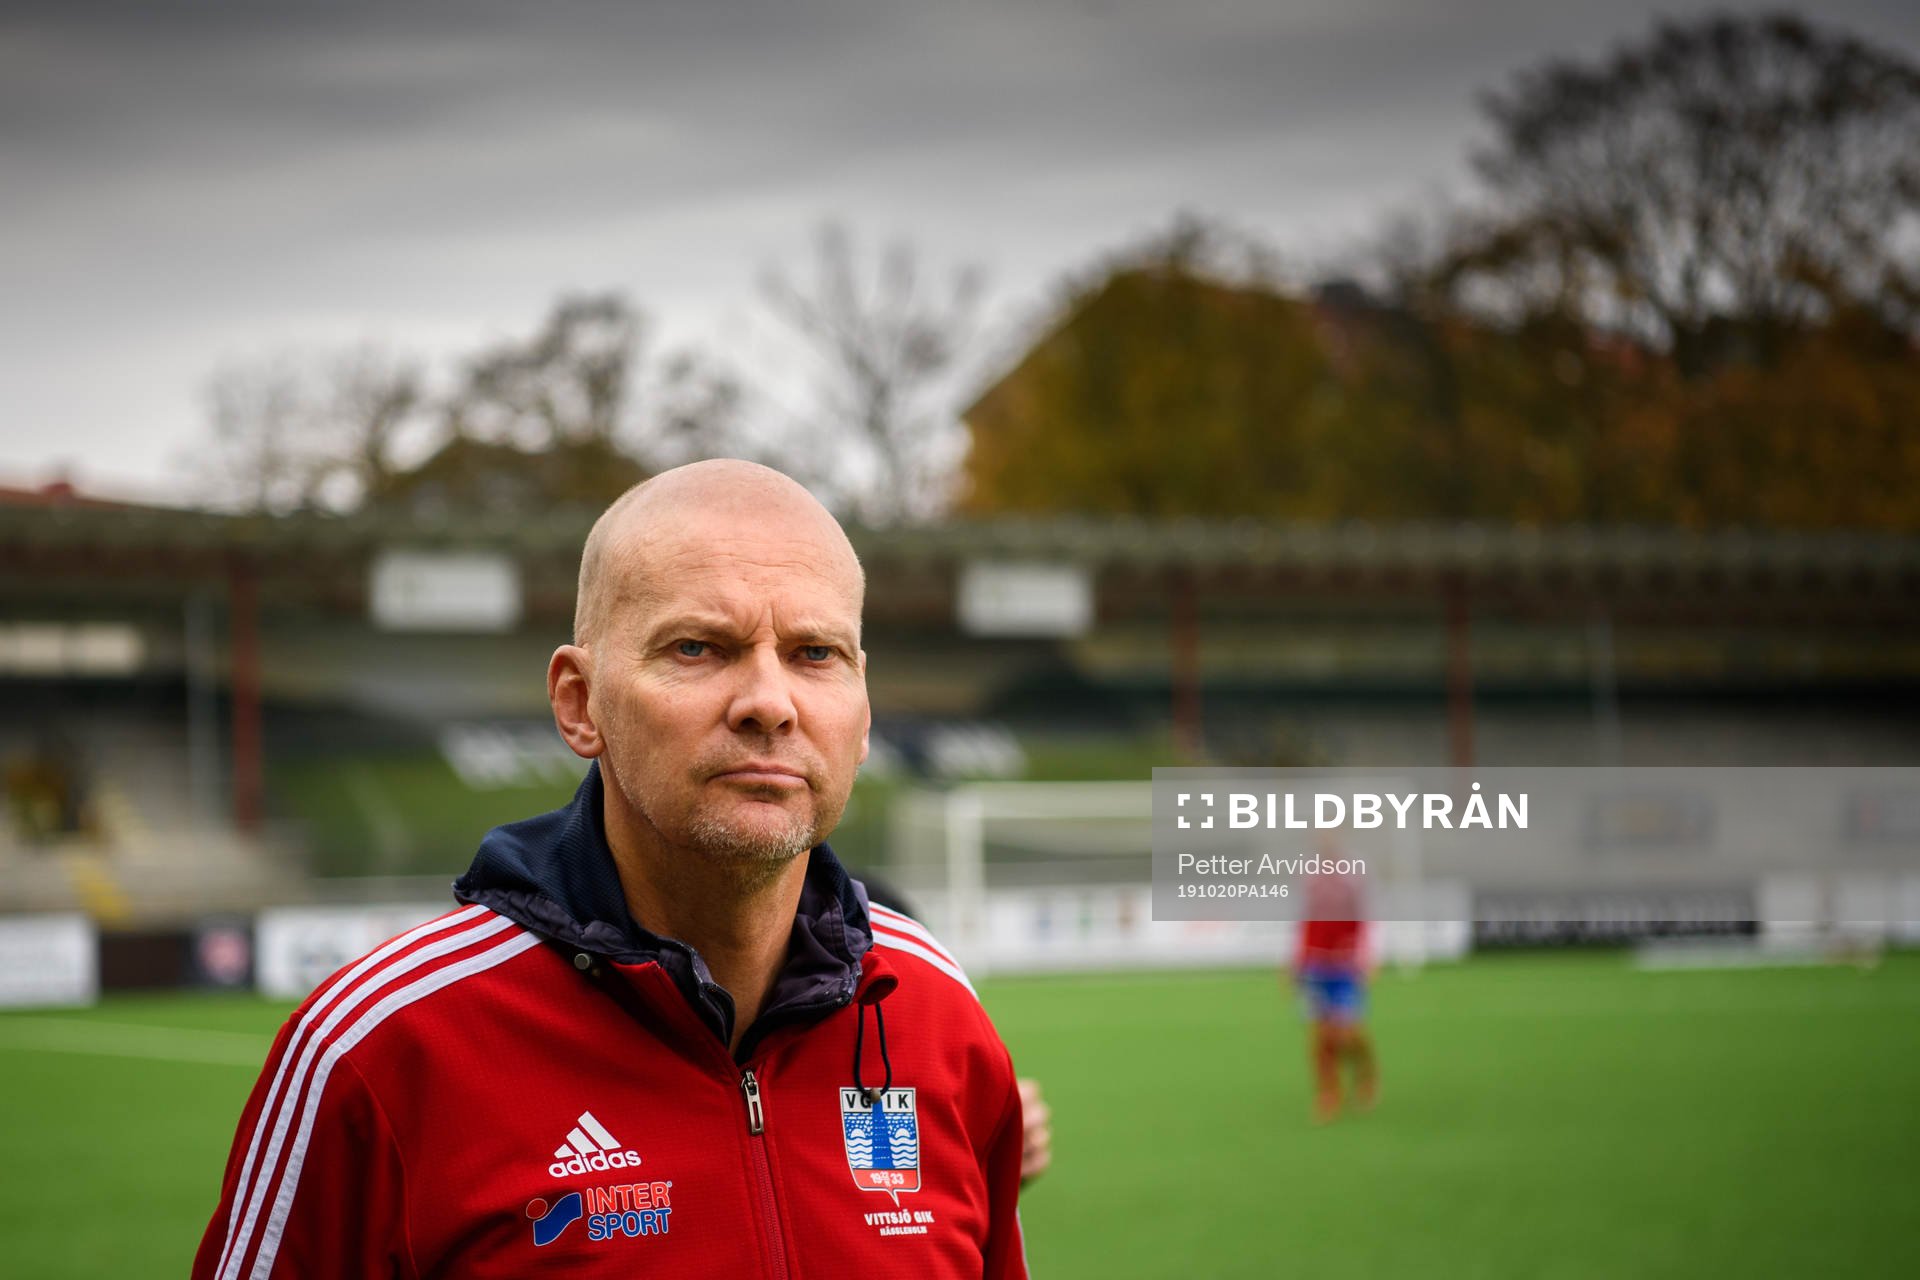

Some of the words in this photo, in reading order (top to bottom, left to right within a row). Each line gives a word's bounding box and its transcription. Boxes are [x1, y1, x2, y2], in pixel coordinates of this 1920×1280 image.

[548, 1150, 642, 1178] adidas
[586, 1181, 671, 1214] INTER
[588, 1207, 672, 1241] SPORT
[864, 1208, 912, 1226] VITTSJÖ
[913, 1210, 935, 1223] GIK
